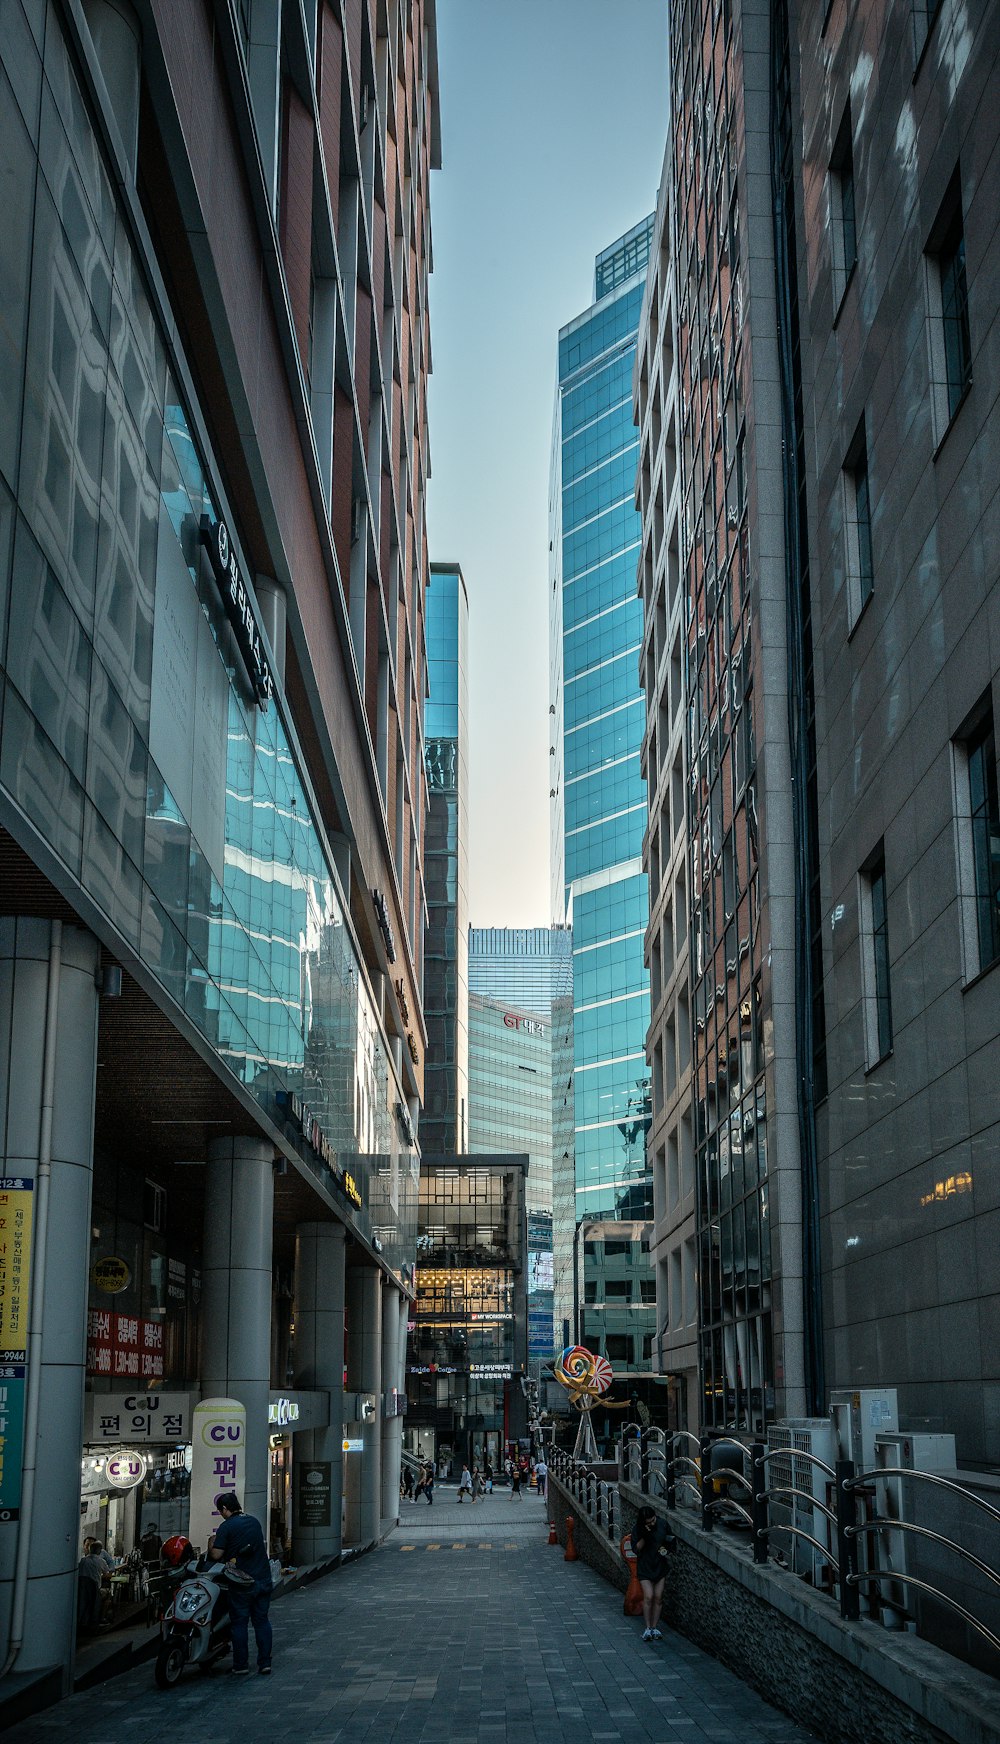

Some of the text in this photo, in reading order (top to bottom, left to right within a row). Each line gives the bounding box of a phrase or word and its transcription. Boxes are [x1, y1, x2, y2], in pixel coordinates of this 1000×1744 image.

[230, 551, 262, 676] 필라테스
[0, 1179, 25, 1189] 12호
[125, 1396, 159, 1410] CU
[211, 1426, 240, 1441] CU
[167, 1450, 185, 1470] HELLO
[109, 1462, 140, 1475] CU
